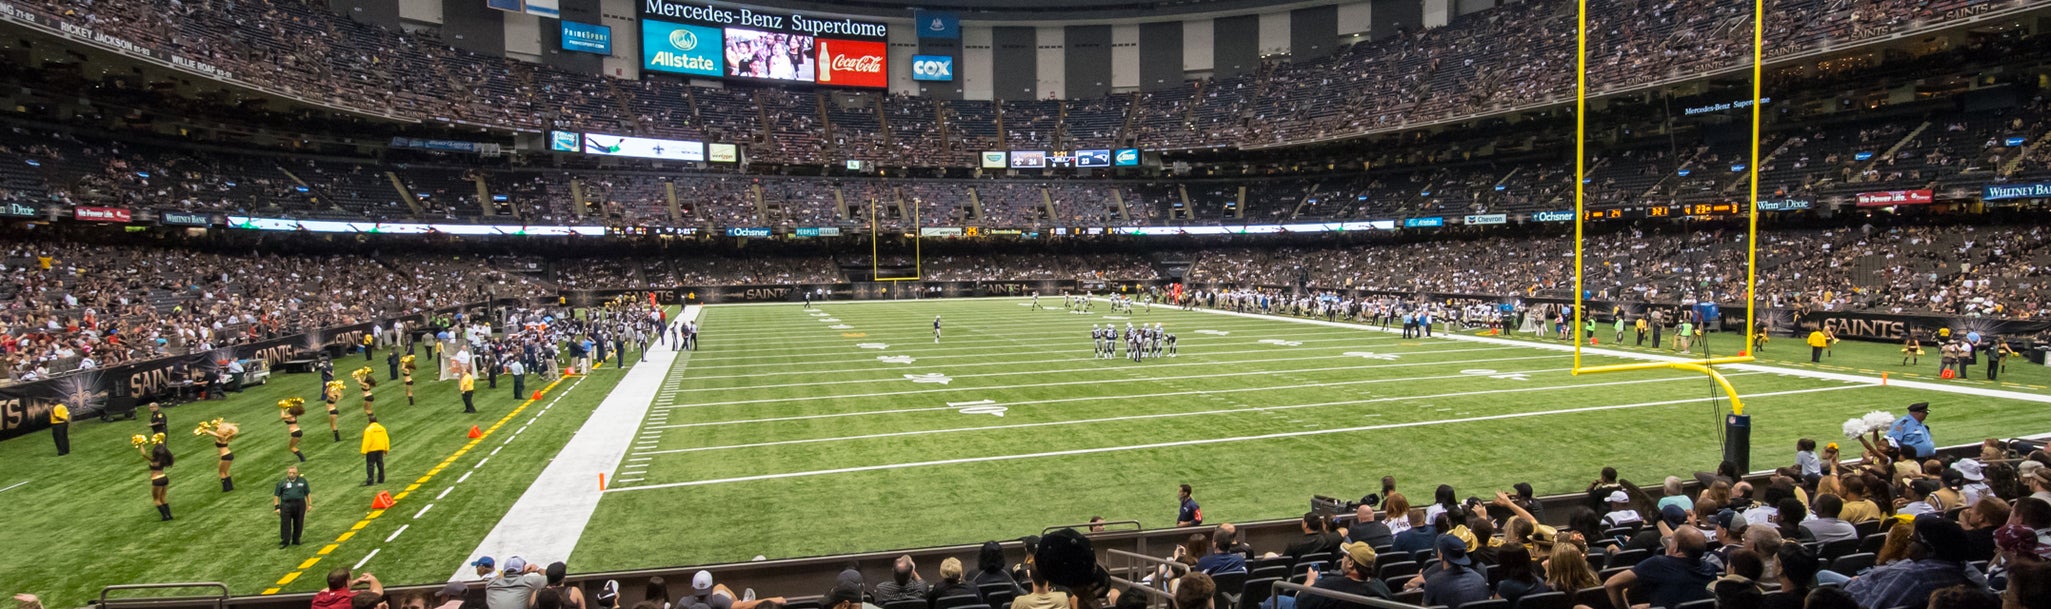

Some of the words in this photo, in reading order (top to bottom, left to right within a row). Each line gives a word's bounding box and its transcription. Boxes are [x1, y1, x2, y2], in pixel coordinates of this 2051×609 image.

[1946, 4, 1988, 19] SAINTS
[646, 0, 783, 29] Mercedes-Benz
[791, 15, 886, 37] Superdome
[61, 21, 92, 39] RICKEY
[94, 32, 132, 50] JACKSON
[1850, 25, 1889, 41] SAINTS
[171, 55, 196, 69] WILLIE
[197, 62, 216, 73] ROAF
[651, 51, 714, 72] Allstate
[832, 53, 883, 73] Coca-Cola
[1684, 103, 1730, 115] Mercedes-Benz
[1989, 187, 2034, 197] WHITNEY
[1757, 201, 1778, 210] Winn
[1786, 199, 1808, 208] Dixie
[1870, 194, 1891, 203] Power
[12, 204, 35, 216] Dixie
[78, 209, 86, 217] We
[86, 209, 103, 218] Power
[1611, 209, 1621, 217] 24
[1695, 205, 1706, 214] 23
[165, 213, 191, 223] WHITNEY
[191, 215, 207, 224] BANK
[1477, 215, 1503, 223] Chevron
[1539, 212, 1573, 221] Ochsner
[734, 227, 768, 236] Ochsner
[1825, 317, 1905, 340] SAINTS
[335, 330, 363, 346] SAINTS
